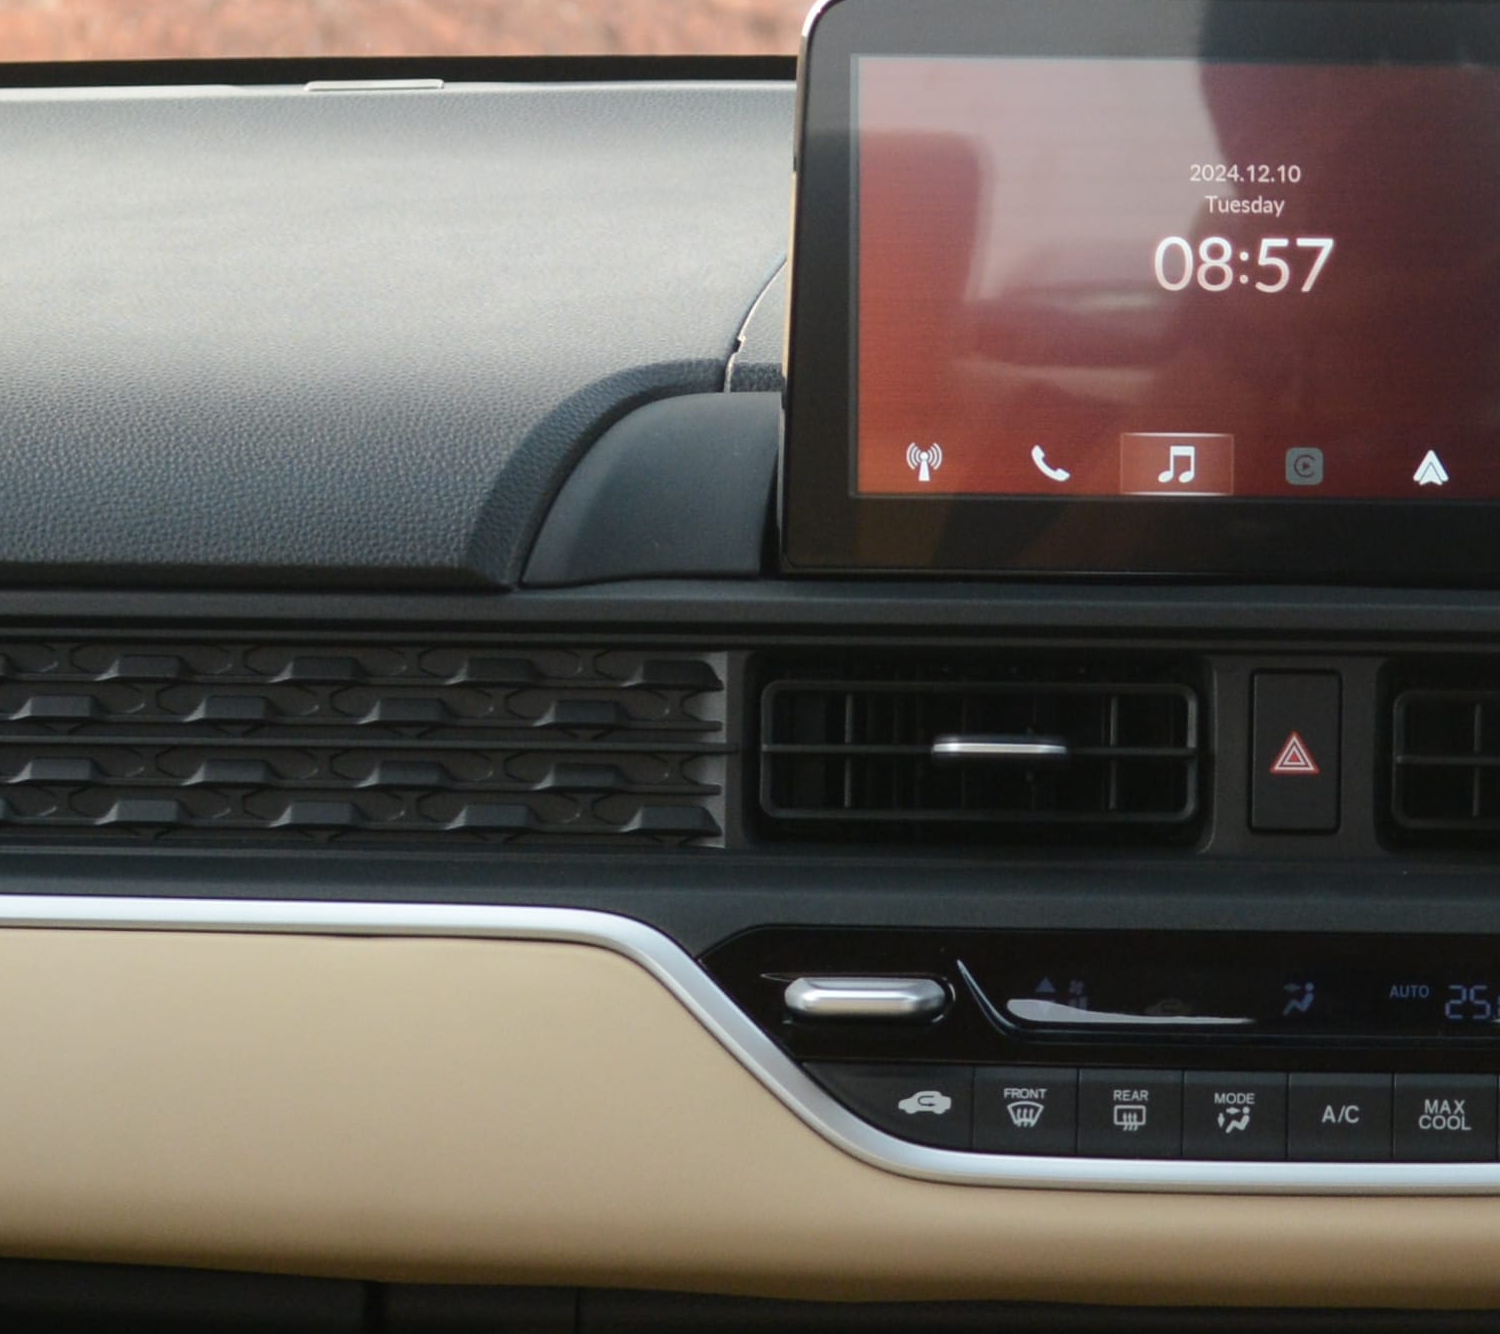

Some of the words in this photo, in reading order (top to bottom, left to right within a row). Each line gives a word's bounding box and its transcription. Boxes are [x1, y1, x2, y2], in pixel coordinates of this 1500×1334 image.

[1189, 164, 1302, 183] 2024.12.10
[1204, 195, 1285, 217] Tuesday
[1154, 236, 1334, 293] 08:57
[1389, 985, 1430, 999] AUTO
[1003, 1088, 1047, 1099] FRONT
[1113, 1090, 1149, 1101] REAR
[1214, 1093, 1255, 1104] MODE
[1322, 1105, 1360, 1124] A/C
[1424, 1099, 1465, 1115] MAX
[1418, 1115, 1472, 1130] COOL
